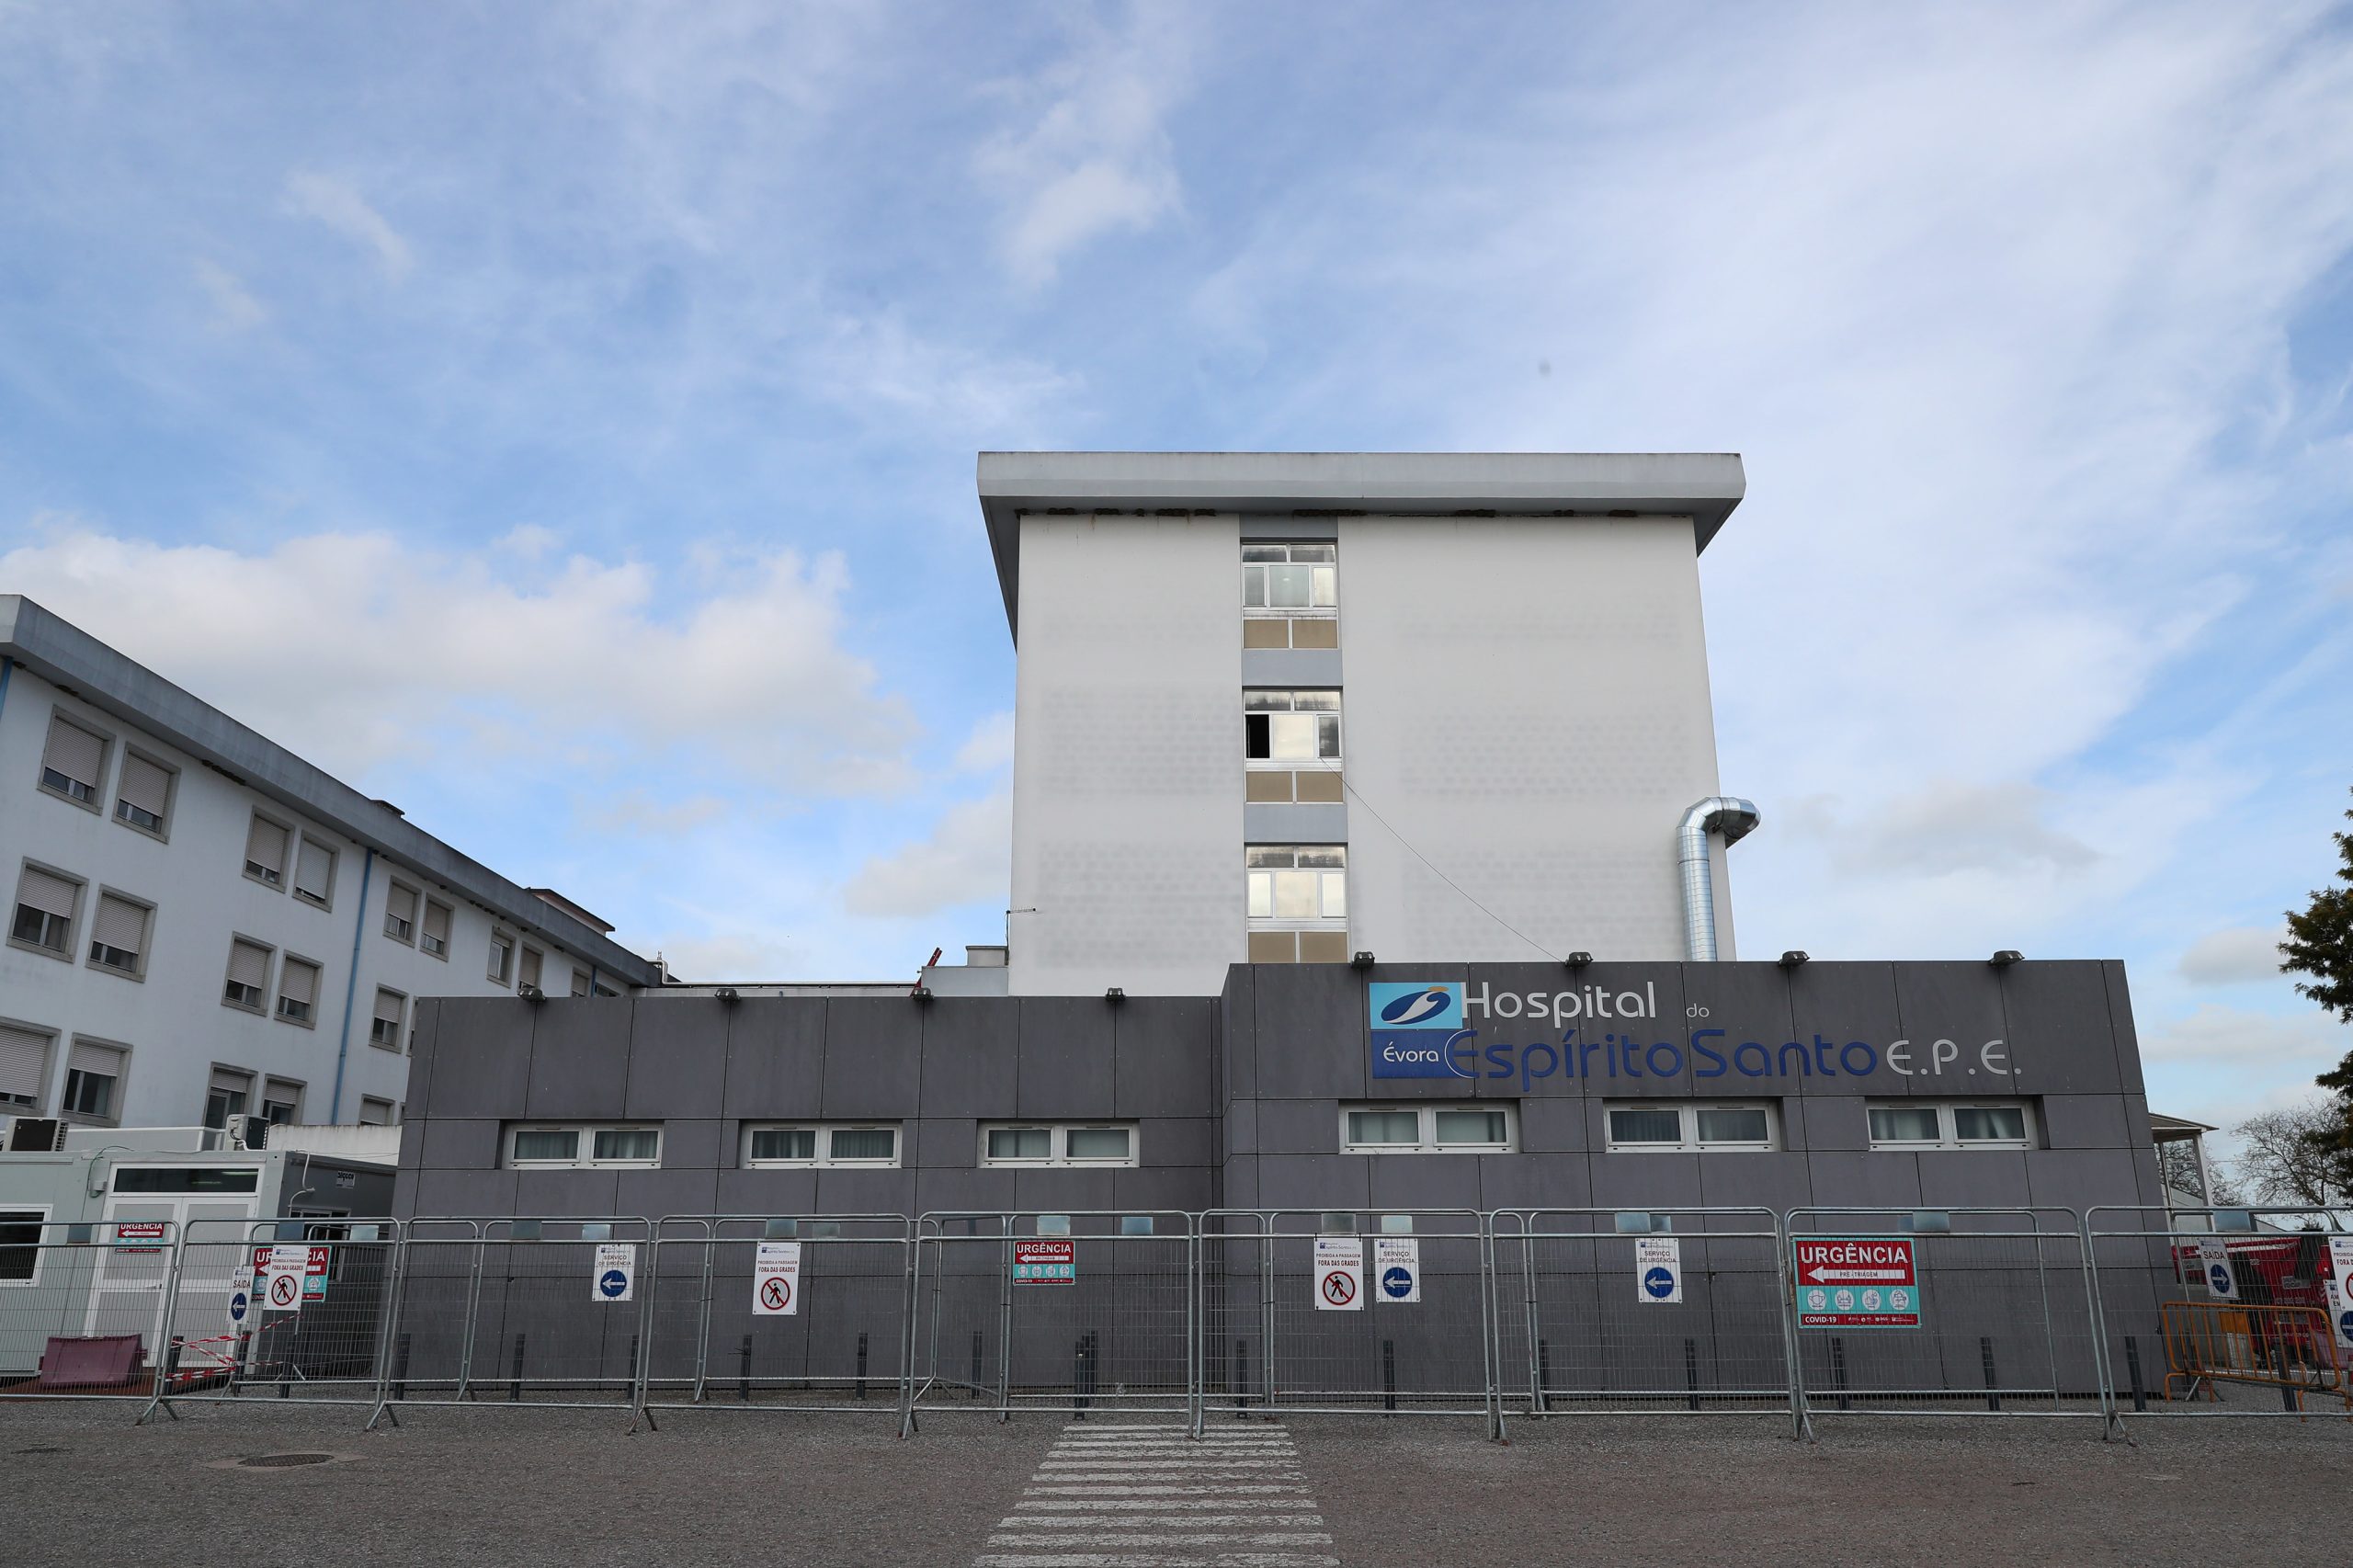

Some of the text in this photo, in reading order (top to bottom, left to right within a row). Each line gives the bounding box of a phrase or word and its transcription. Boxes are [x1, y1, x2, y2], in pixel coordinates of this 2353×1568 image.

[1460, 981, 1710, 1028] Hospital do
[1383, 1041, 1439, 1062] Évora
[1445, 1028, 2022, 1092] Espírito Santo E.P.E.
[1017, 1243, 1072, 1253] URGÊNCIA
[1800, 1243, 1908, 1264] URGÊNCIA
[1804, 1315, 1837, 1324] COVID-19
